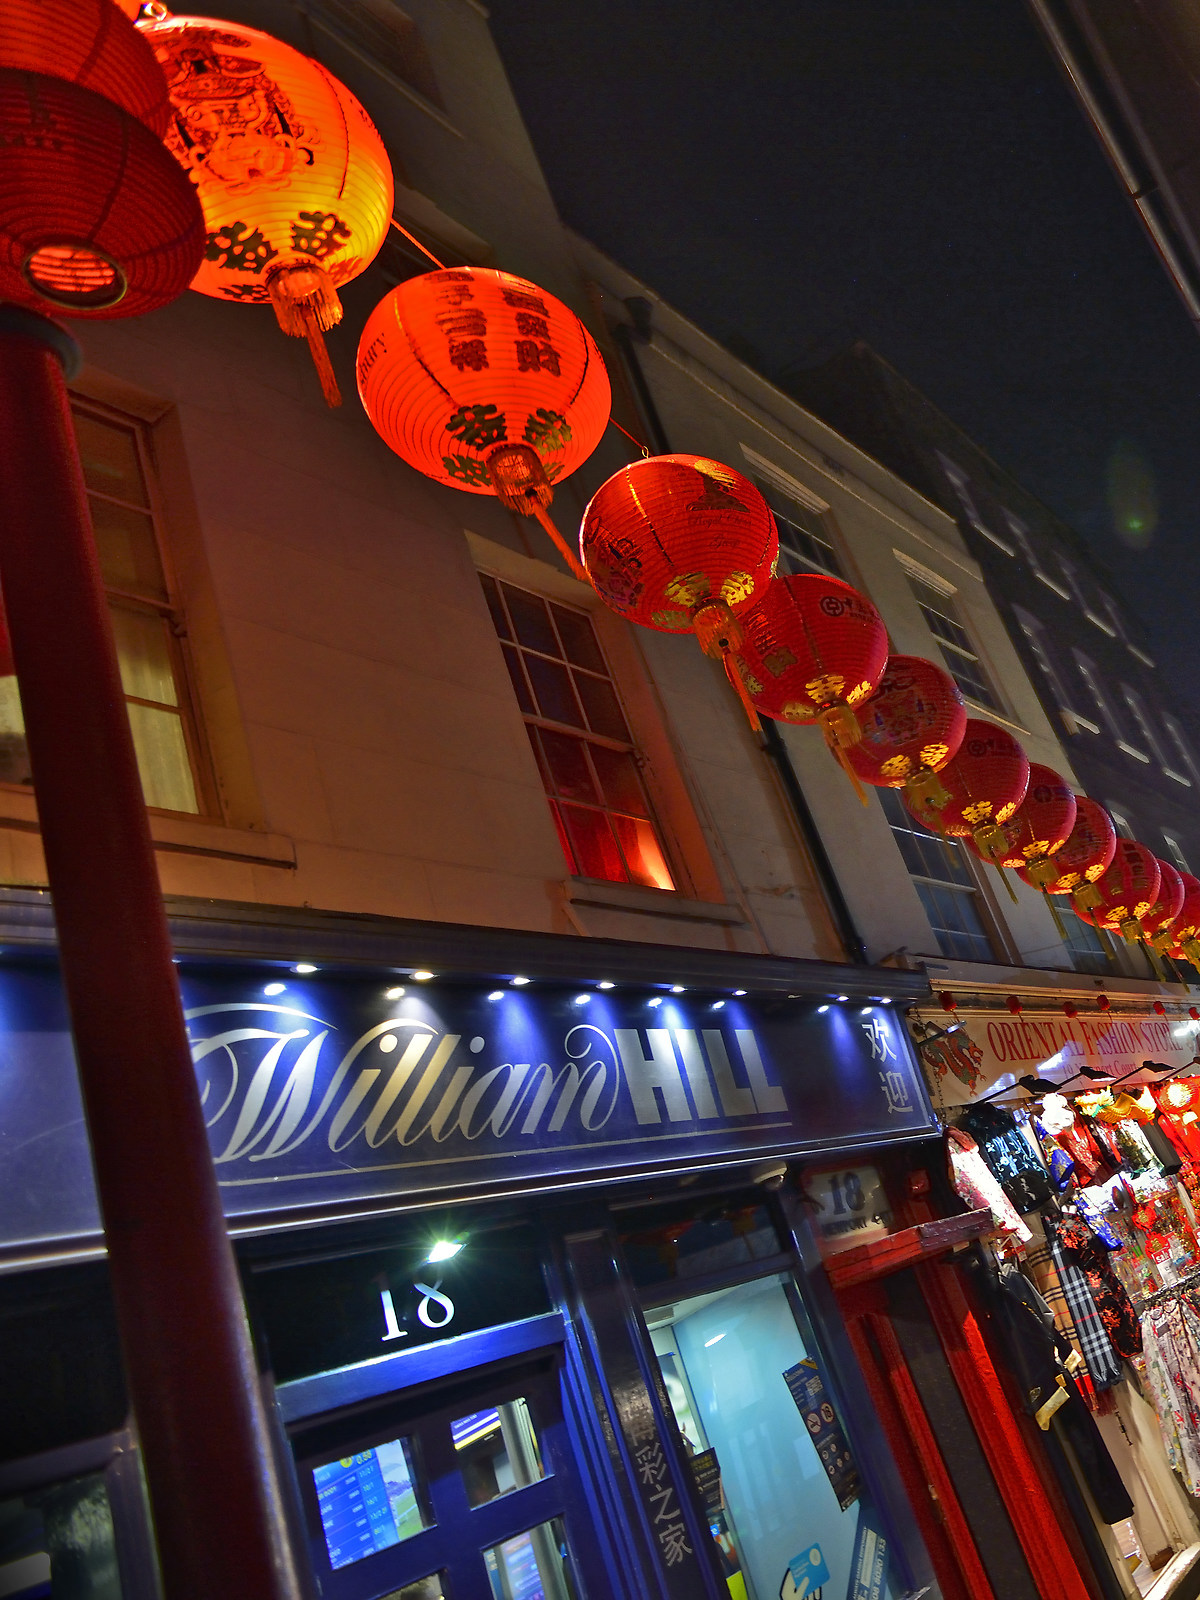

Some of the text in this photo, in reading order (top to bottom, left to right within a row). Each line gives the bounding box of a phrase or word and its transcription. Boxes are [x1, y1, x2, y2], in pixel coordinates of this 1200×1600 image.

[861, 1016, 915, 1116] 欢迎
[986, 1020, 1184, 1063] ORIENTAL FASHION STORE
[184, 1002, 789, 1164] William HILL
[828, 1171, 866, 1216] 18
[379, 1279, 456, 1345] 18
